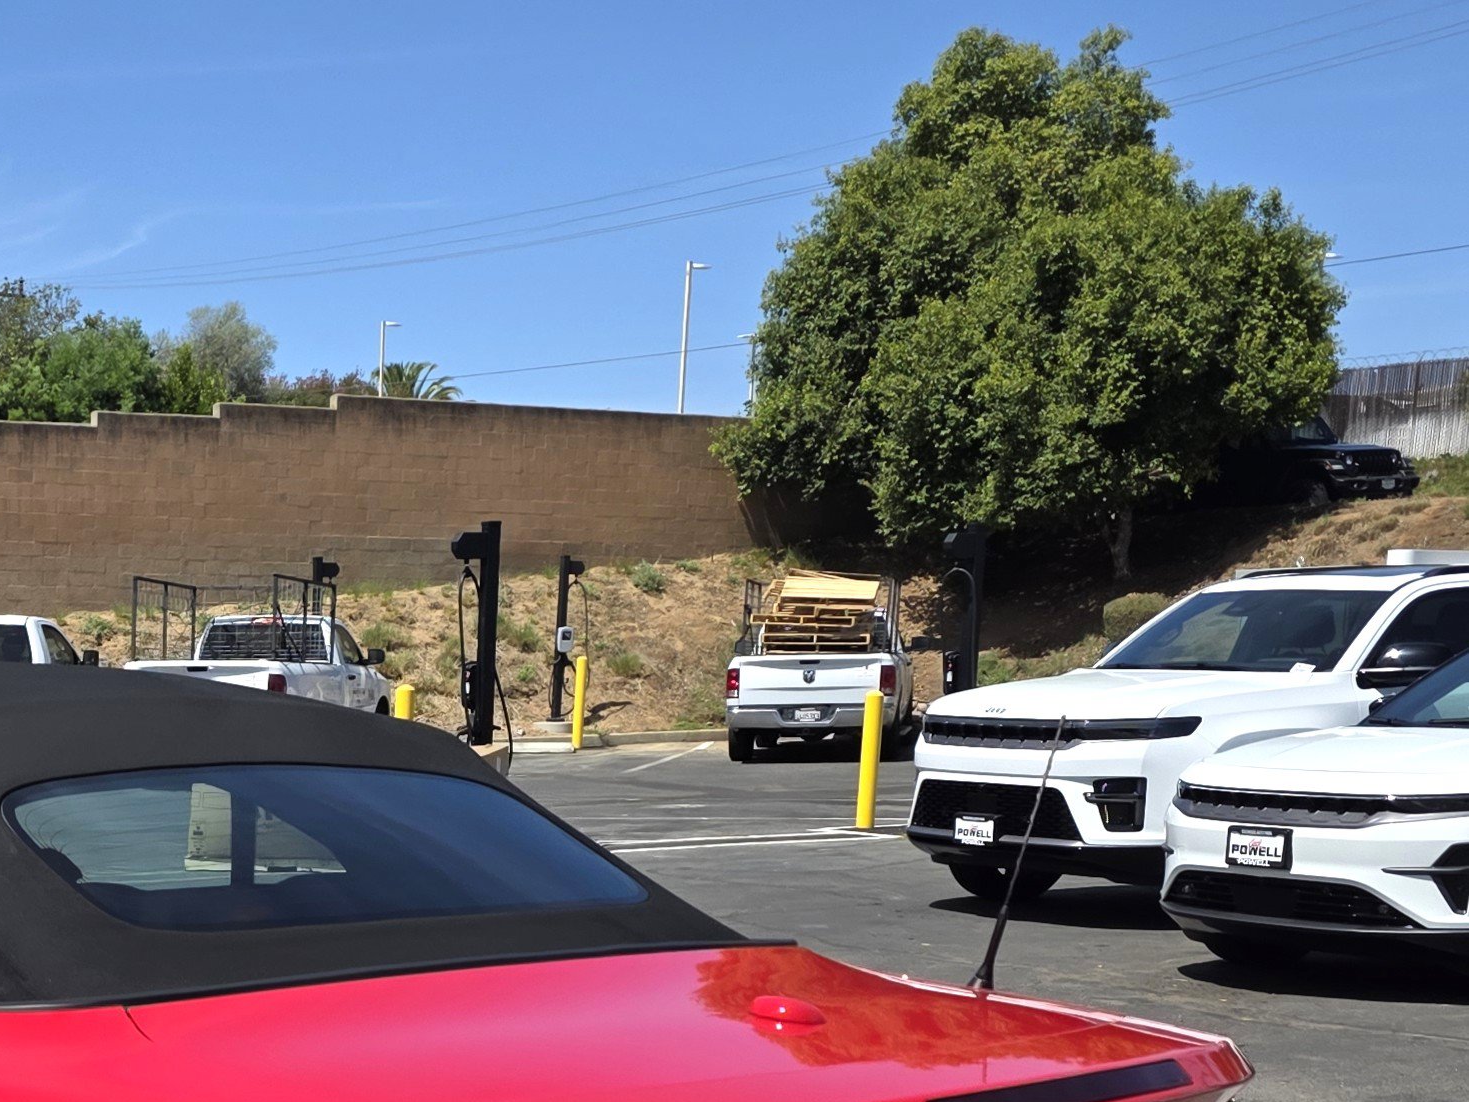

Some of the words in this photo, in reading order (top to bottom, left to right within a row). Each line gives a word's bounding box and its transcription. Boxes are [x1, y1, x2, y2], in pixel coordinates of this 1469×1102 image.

[984, 706, 1007, 714] Jeep
[957, 827, 992, 839] POWELL
[1232, 843, 1282, 858] POWELL
